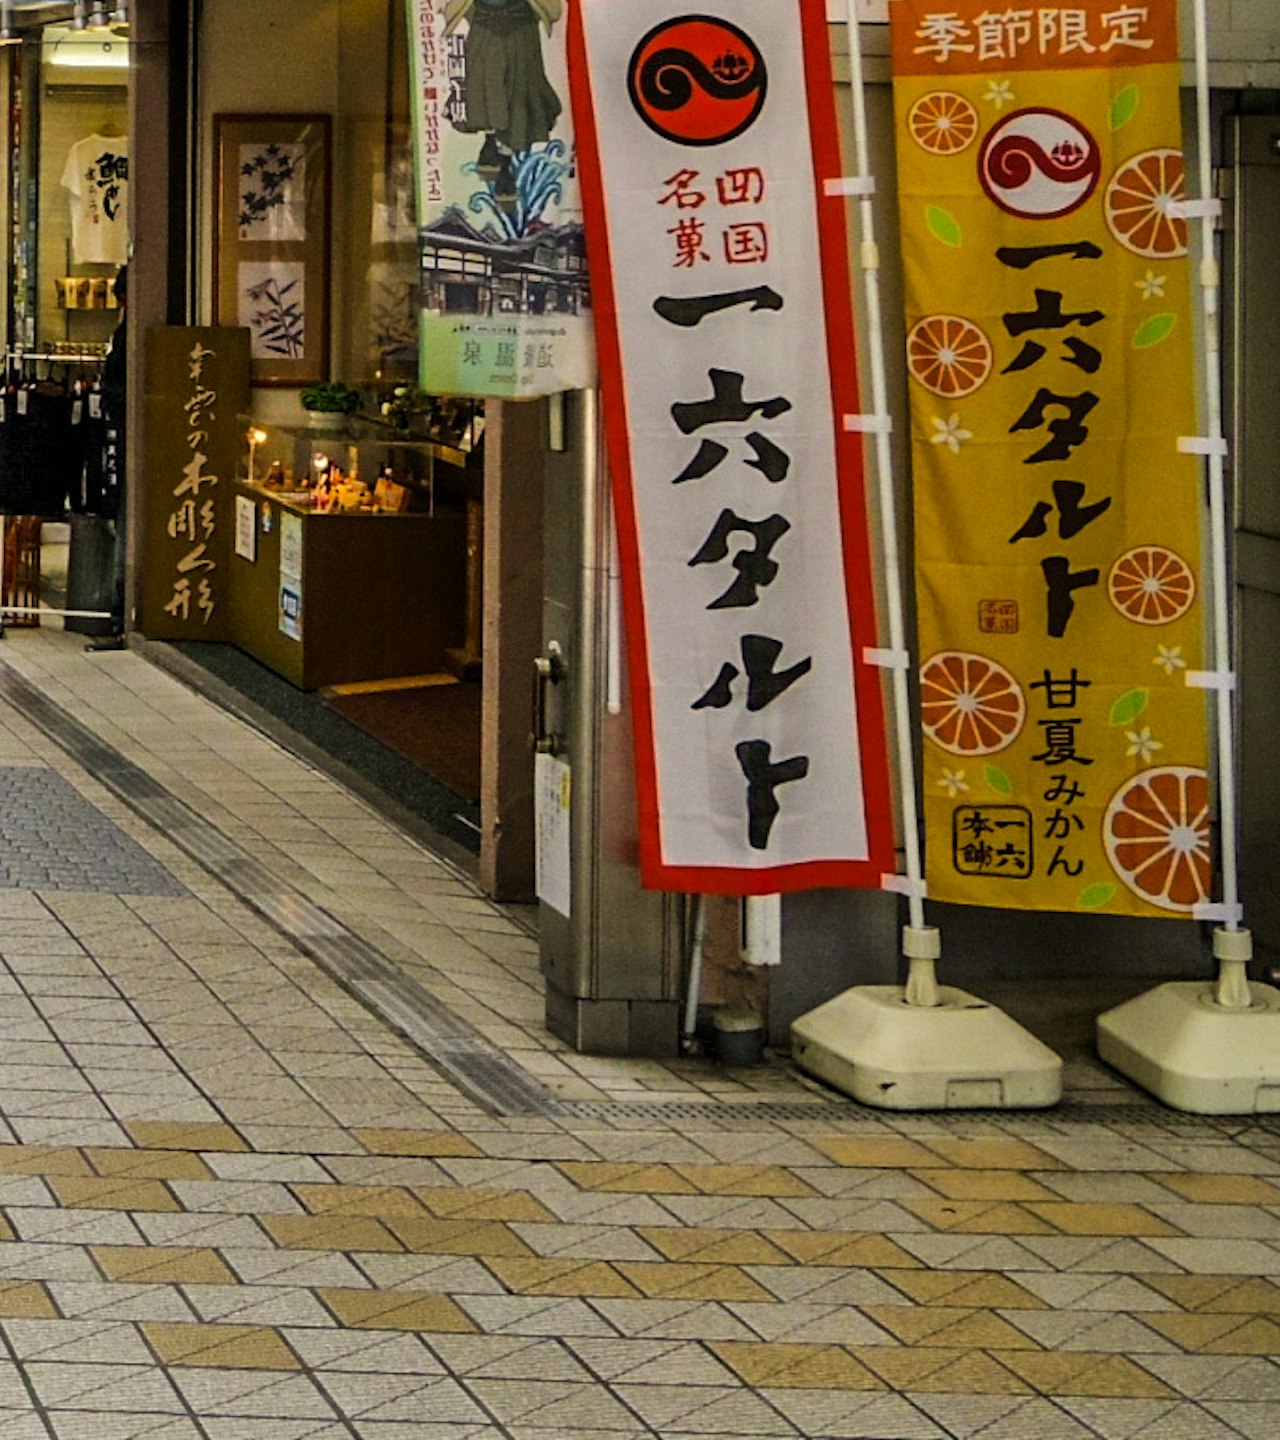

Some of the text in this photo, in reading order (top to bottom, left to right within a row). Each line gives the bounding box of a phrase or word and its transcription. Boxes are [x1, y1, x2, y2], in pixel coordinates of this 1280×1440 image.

[912, 4, 1155, 63] 季節限定
[657, 166, 769, 268] 四国 名菓
[994, 240, 1112, 637] 一六タルト
[652, 284, 812, 851] 一六タルト
[1029, 667, 1094, 878] 甘夏みかん
